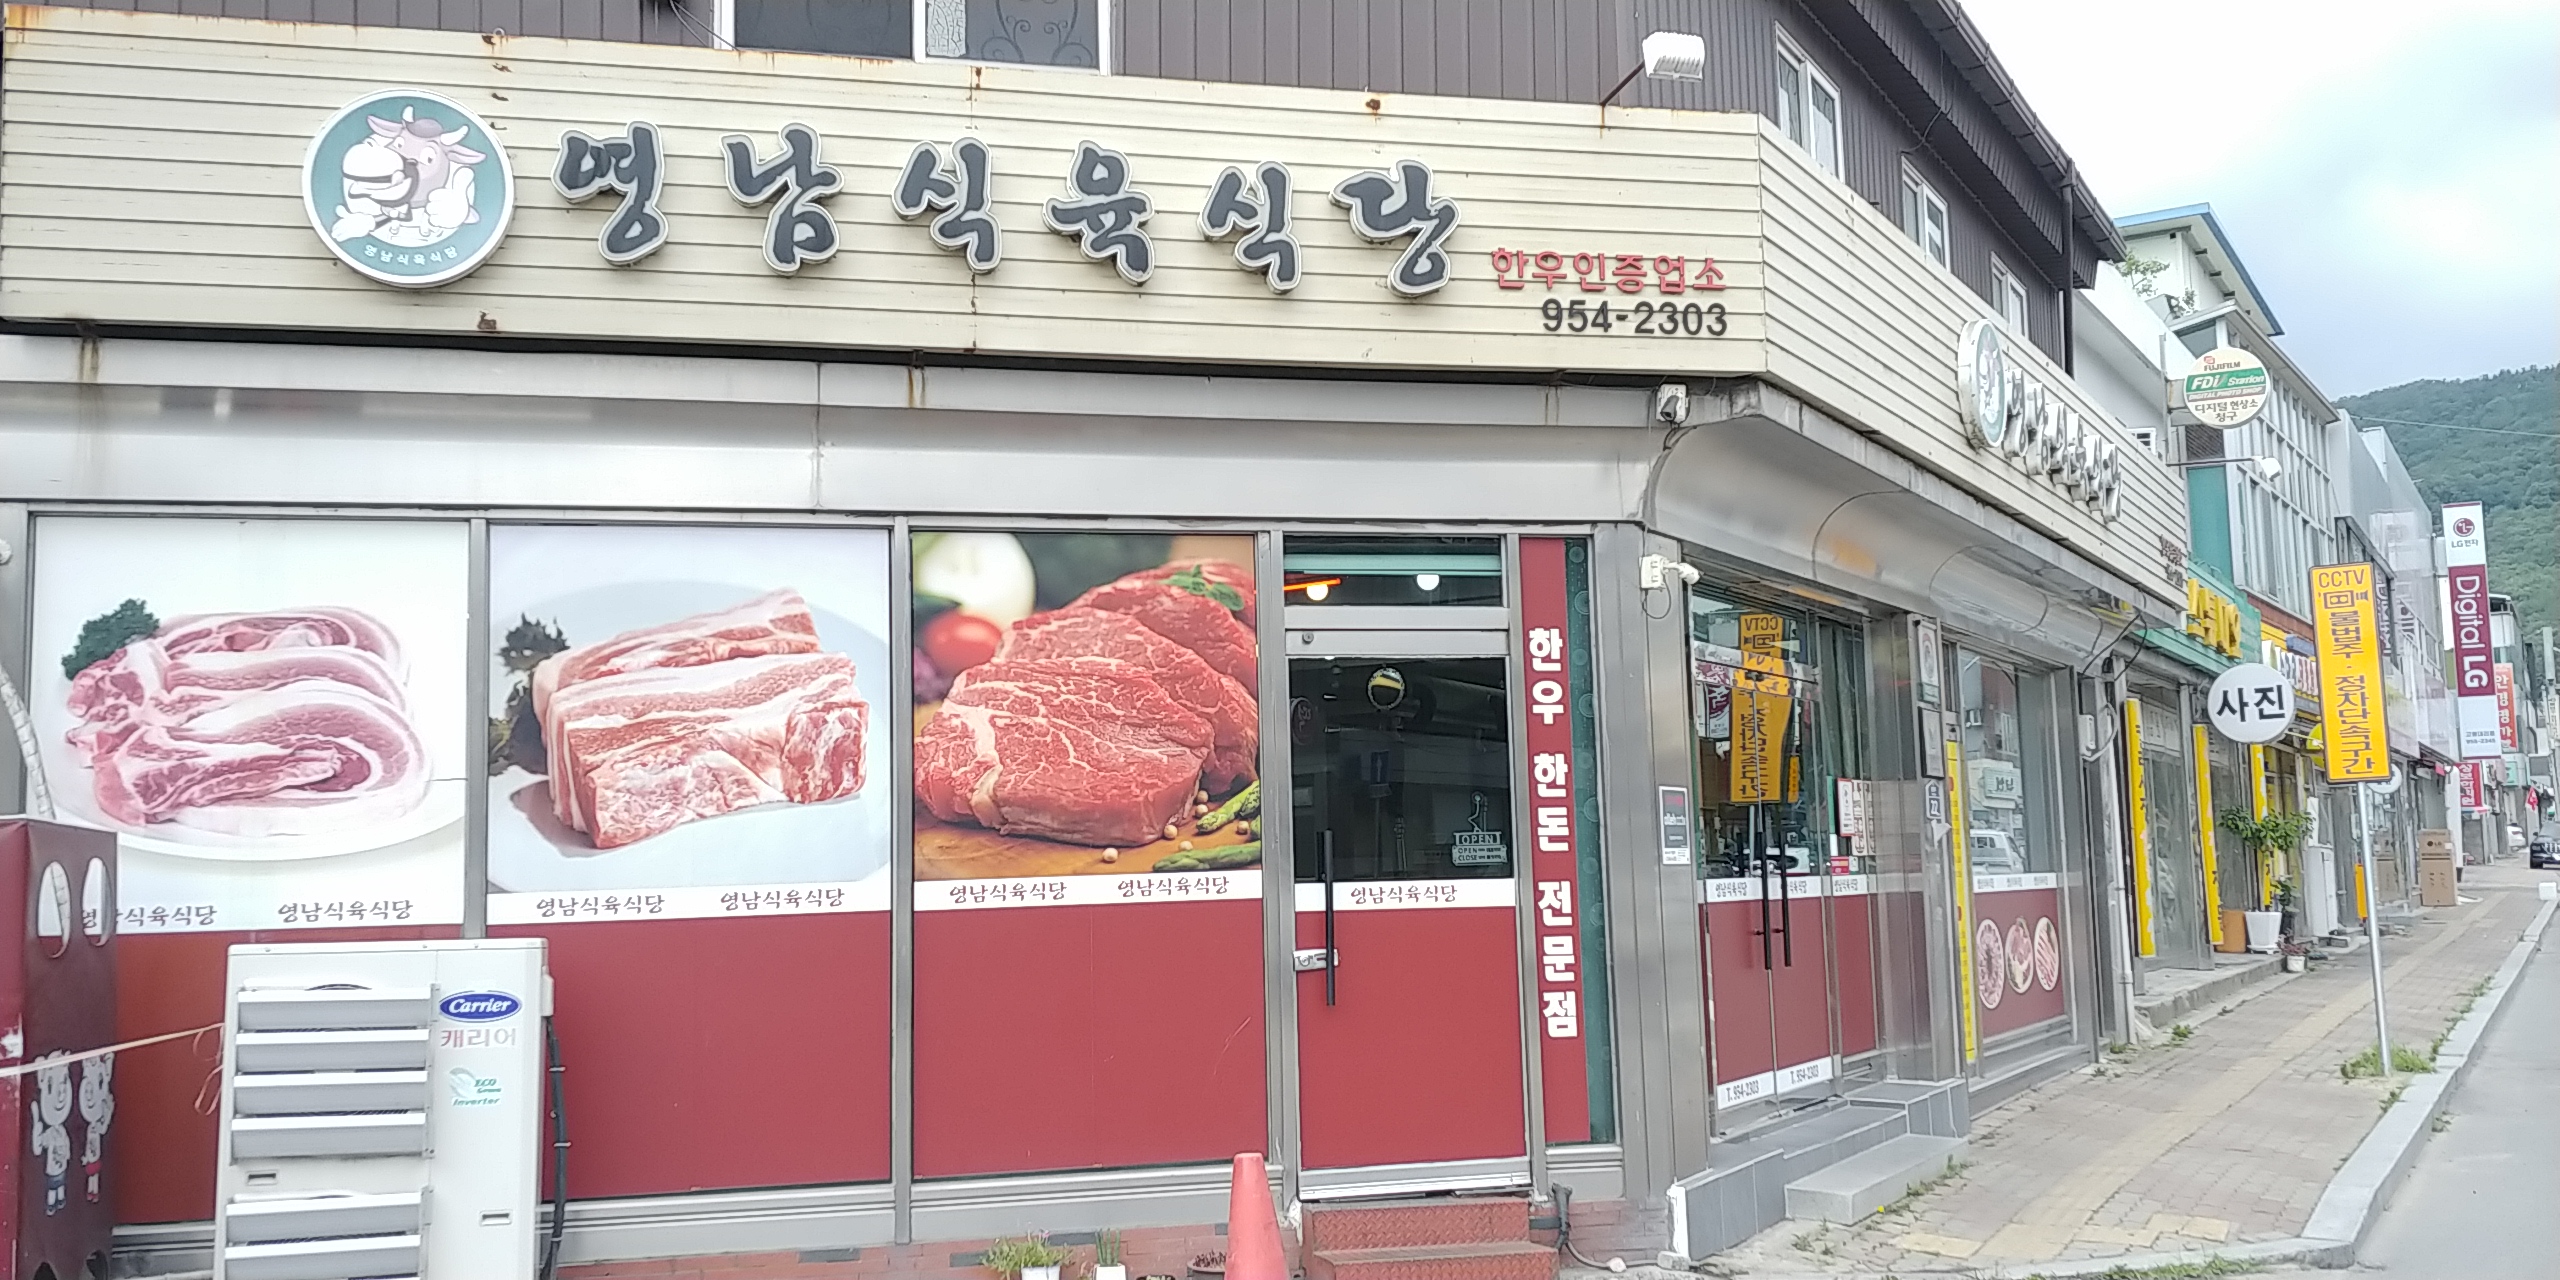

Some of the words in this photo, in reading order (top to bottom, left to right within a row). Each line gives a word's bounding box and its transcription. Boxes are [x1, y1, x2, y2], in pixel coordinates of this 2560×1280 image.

[555, 122, 1460, 297] 영남식육식당
[364, 244, 458, 265] 영남식육식당
[1491, 247, 1728, 295] 한우인증업소
[1541, 298, 1728, 336] 954-2303
[2204, 361, 2241, 371] FUJIFILM
[2227, 375, 2265, 386] Station
[2194, 402, 2228, 413] 디지털
[2230, 399, 2258, 410] 현상소
[2215, 412, 2237, 422] 청구
[2318, 569, 2364, 588] CCTV
[2454, 575, 2485, 649] Digital
[1529, 627, 1563, 725] 한우
[2463, 655, 2488, 688] LG
[2215, 684, 2286, 723] 사진
[1533, 753, 1569, 852] 한돈
[1462, 834, 1494, 844] OPEN
[949, 881, 1068, 903] 영남식육식당
[1117, 876, 1230, 899] 영남식육식당
[1350, 884, 1459, 906] 영남식육식당
[277, 900, 414, 922] 영남식육식당
[536, 894, 665, 918] 영남식육식당
[720, 888, 845, 912] 영남식육식당
[82, 904, 218, 929] 영식육식당
[1538, 881, 1578, 1039] 전문점
[449, 998, 512, 1013] Carrier
[440, 1028, 516, 1048] 캐리어
[474, 1078, 497, 1088] ECO
[453, 1097, 500, 1107] Inverter
